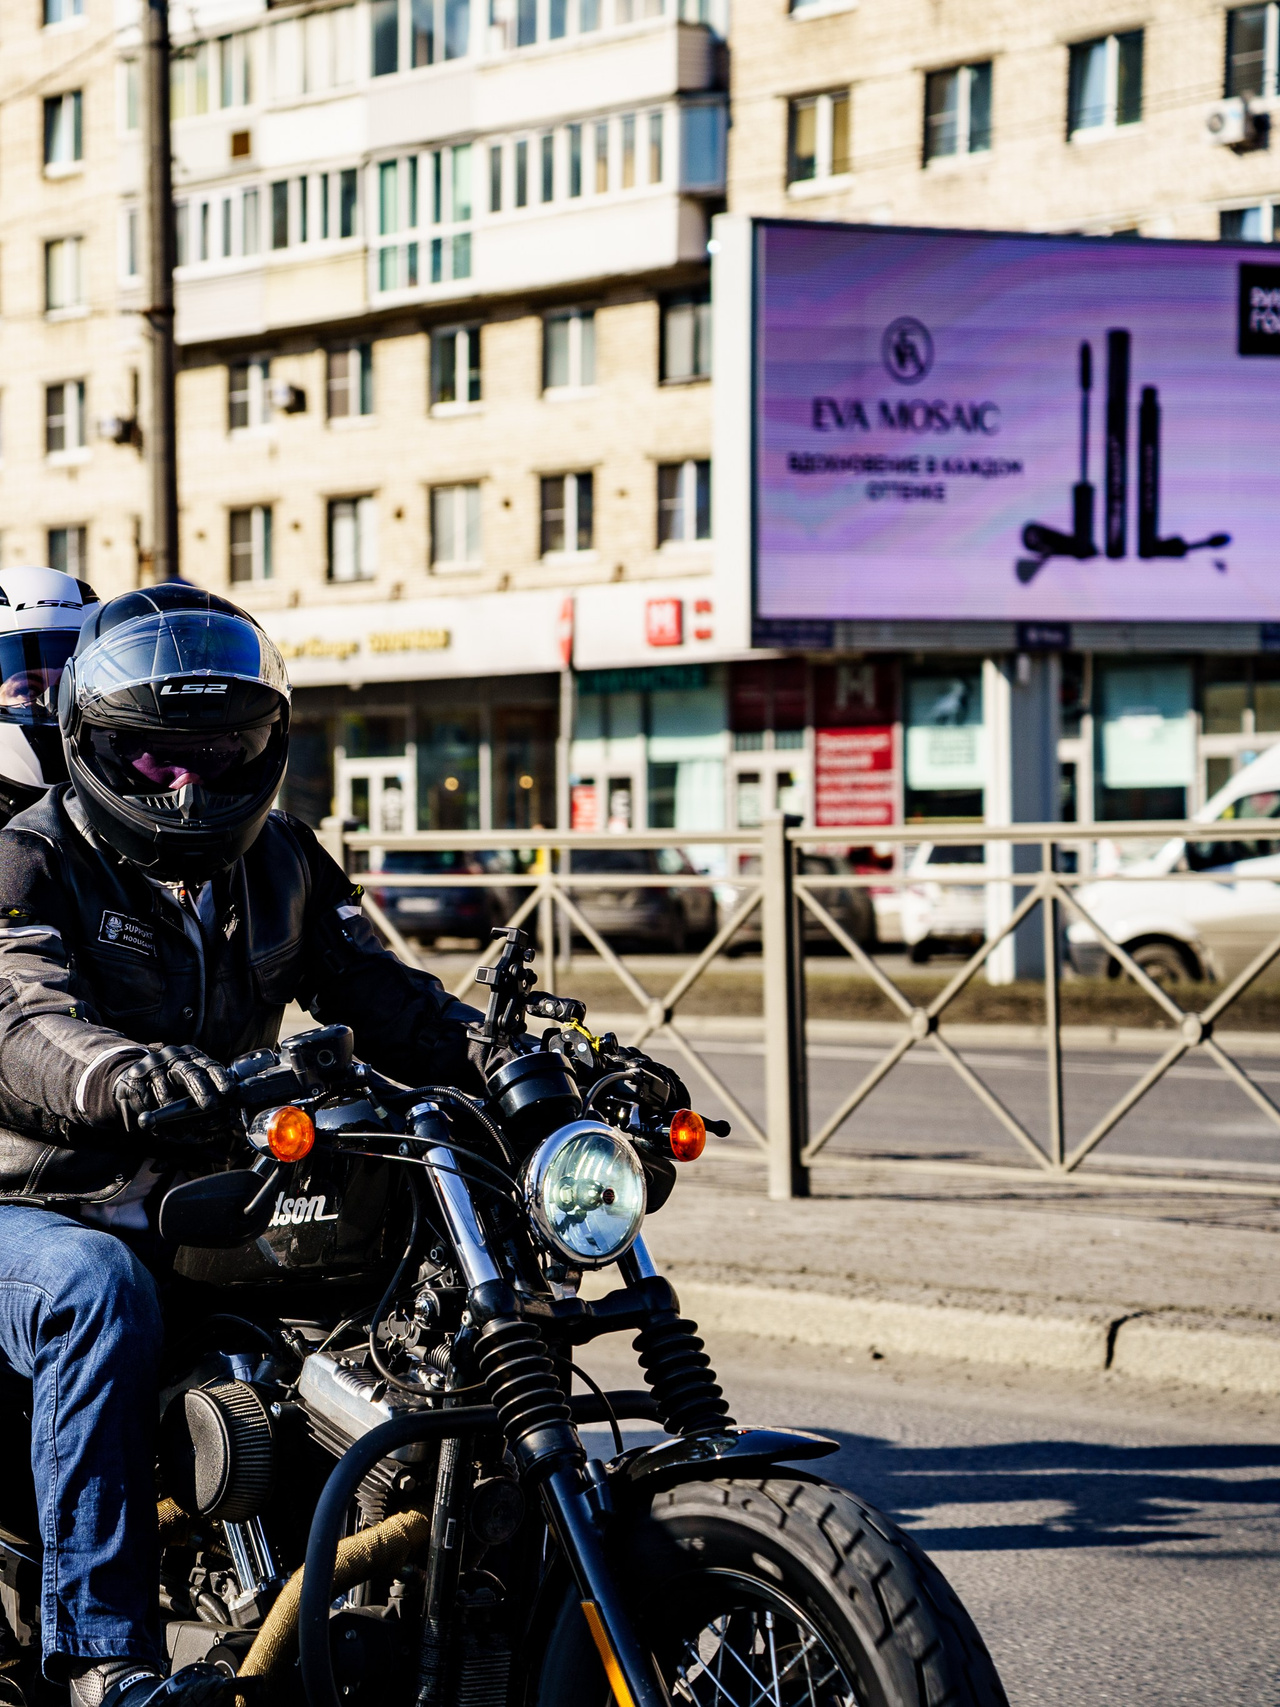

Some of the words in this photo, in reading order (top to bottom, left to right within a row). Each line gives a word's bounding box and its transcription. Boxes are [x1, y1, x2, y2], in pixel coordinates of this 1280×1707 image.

[813, 397, 869, 432] EVA
[879, 400, 1001, 435] MOSAIC
[15, 599, 84, 612] LS2
[159, 684, 229, 696] LS2
[124, 923, 154, 940] SUPPORT
